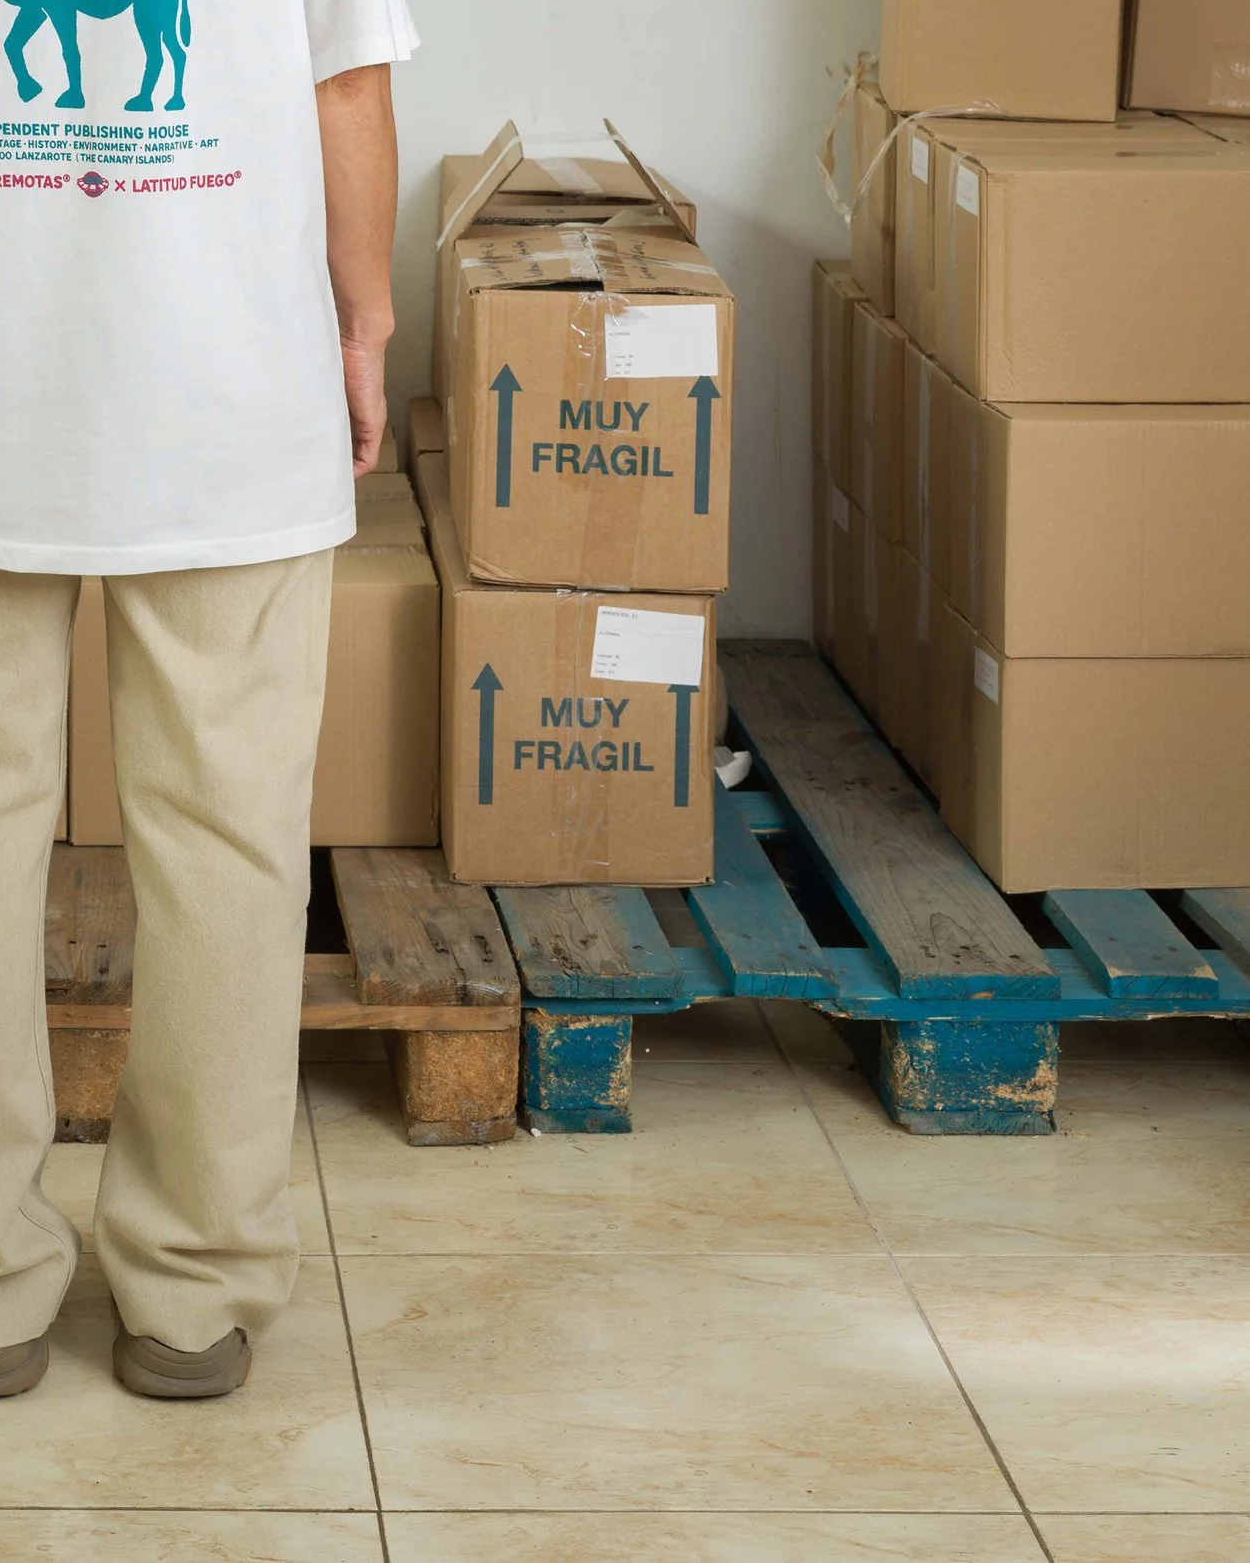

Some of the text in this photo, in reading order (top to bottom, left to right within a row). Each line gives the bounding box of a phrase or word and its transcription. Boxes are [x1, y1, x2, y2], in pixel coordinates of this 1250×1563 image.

[64, 124, 144, 139] PUBLISHING
[148, 124, 189, 138] HOUSE
[28, 140, 67, 149] HISTORY
[73, 141, 137, 152] ENVIRONMENT
[144, 140, 193, 152] NARRATIVE
[200, 138, 219, 148] ART
[15, 151, 72, 161] LANZAROTE
[97, 154, 134, 164] CANARY
[135, 154, 174, 164] ISLANDS)
[132, 176, 187, 192] LATITUD
[559, 399, 650, 431] MUY
[532, 442, 674, 477] FRAGIL
[541, 697, 630, 728] MUY
[514, 740, 655, 772] FRAGIL
